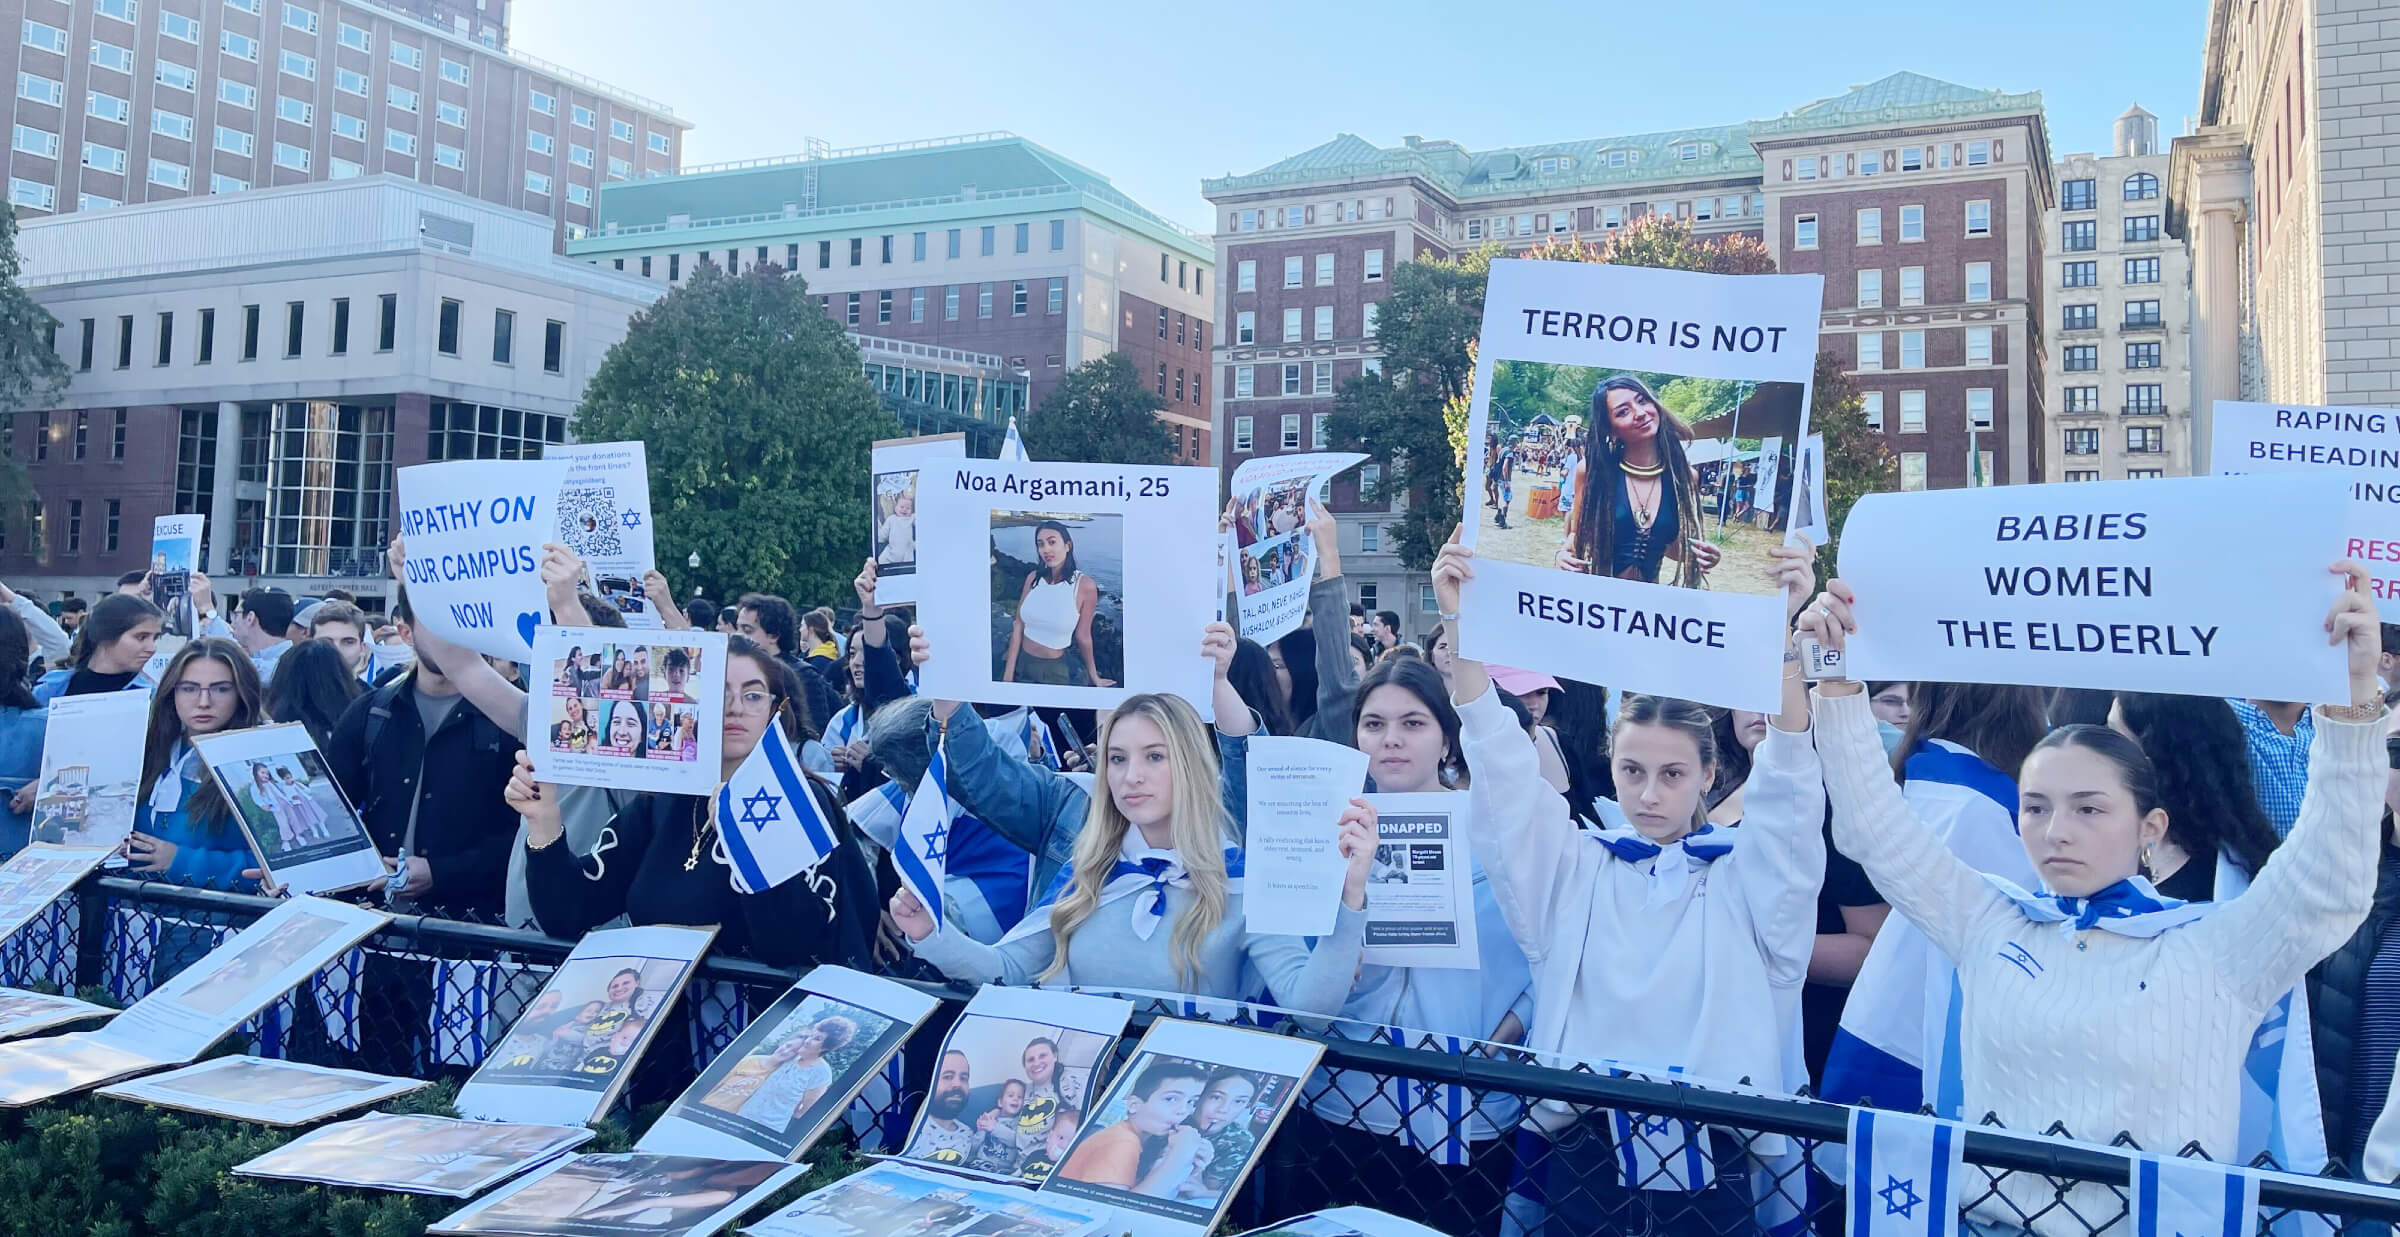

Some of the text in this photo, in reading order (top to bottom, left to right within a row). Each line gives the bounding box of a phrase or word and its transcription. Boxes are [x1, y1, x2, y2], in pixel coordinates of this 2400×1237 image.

[1522, 309, 1787, 353] TERROR IS NOT
[2276, 410, 2386, 434] RAPING
[2250, 441, 2400, 469] BEHEADIN
[955, 470, 1170, 501] Noa Argamani, 25
[490, 496, 536, 524] ON
[157, 523, 184, 536] EXCUSE
[1996, 512, 2148, 541] BABIES
[406, 545, 535, 583] OUR CAMPUS
[1984, 566, 2152, 597] WOMEN
[450, 601, 493, 628] NOW
[1518, 591, 1727, 648] RESISTANCE
[1937, 619, 2219, 657] THE ELDERLY
